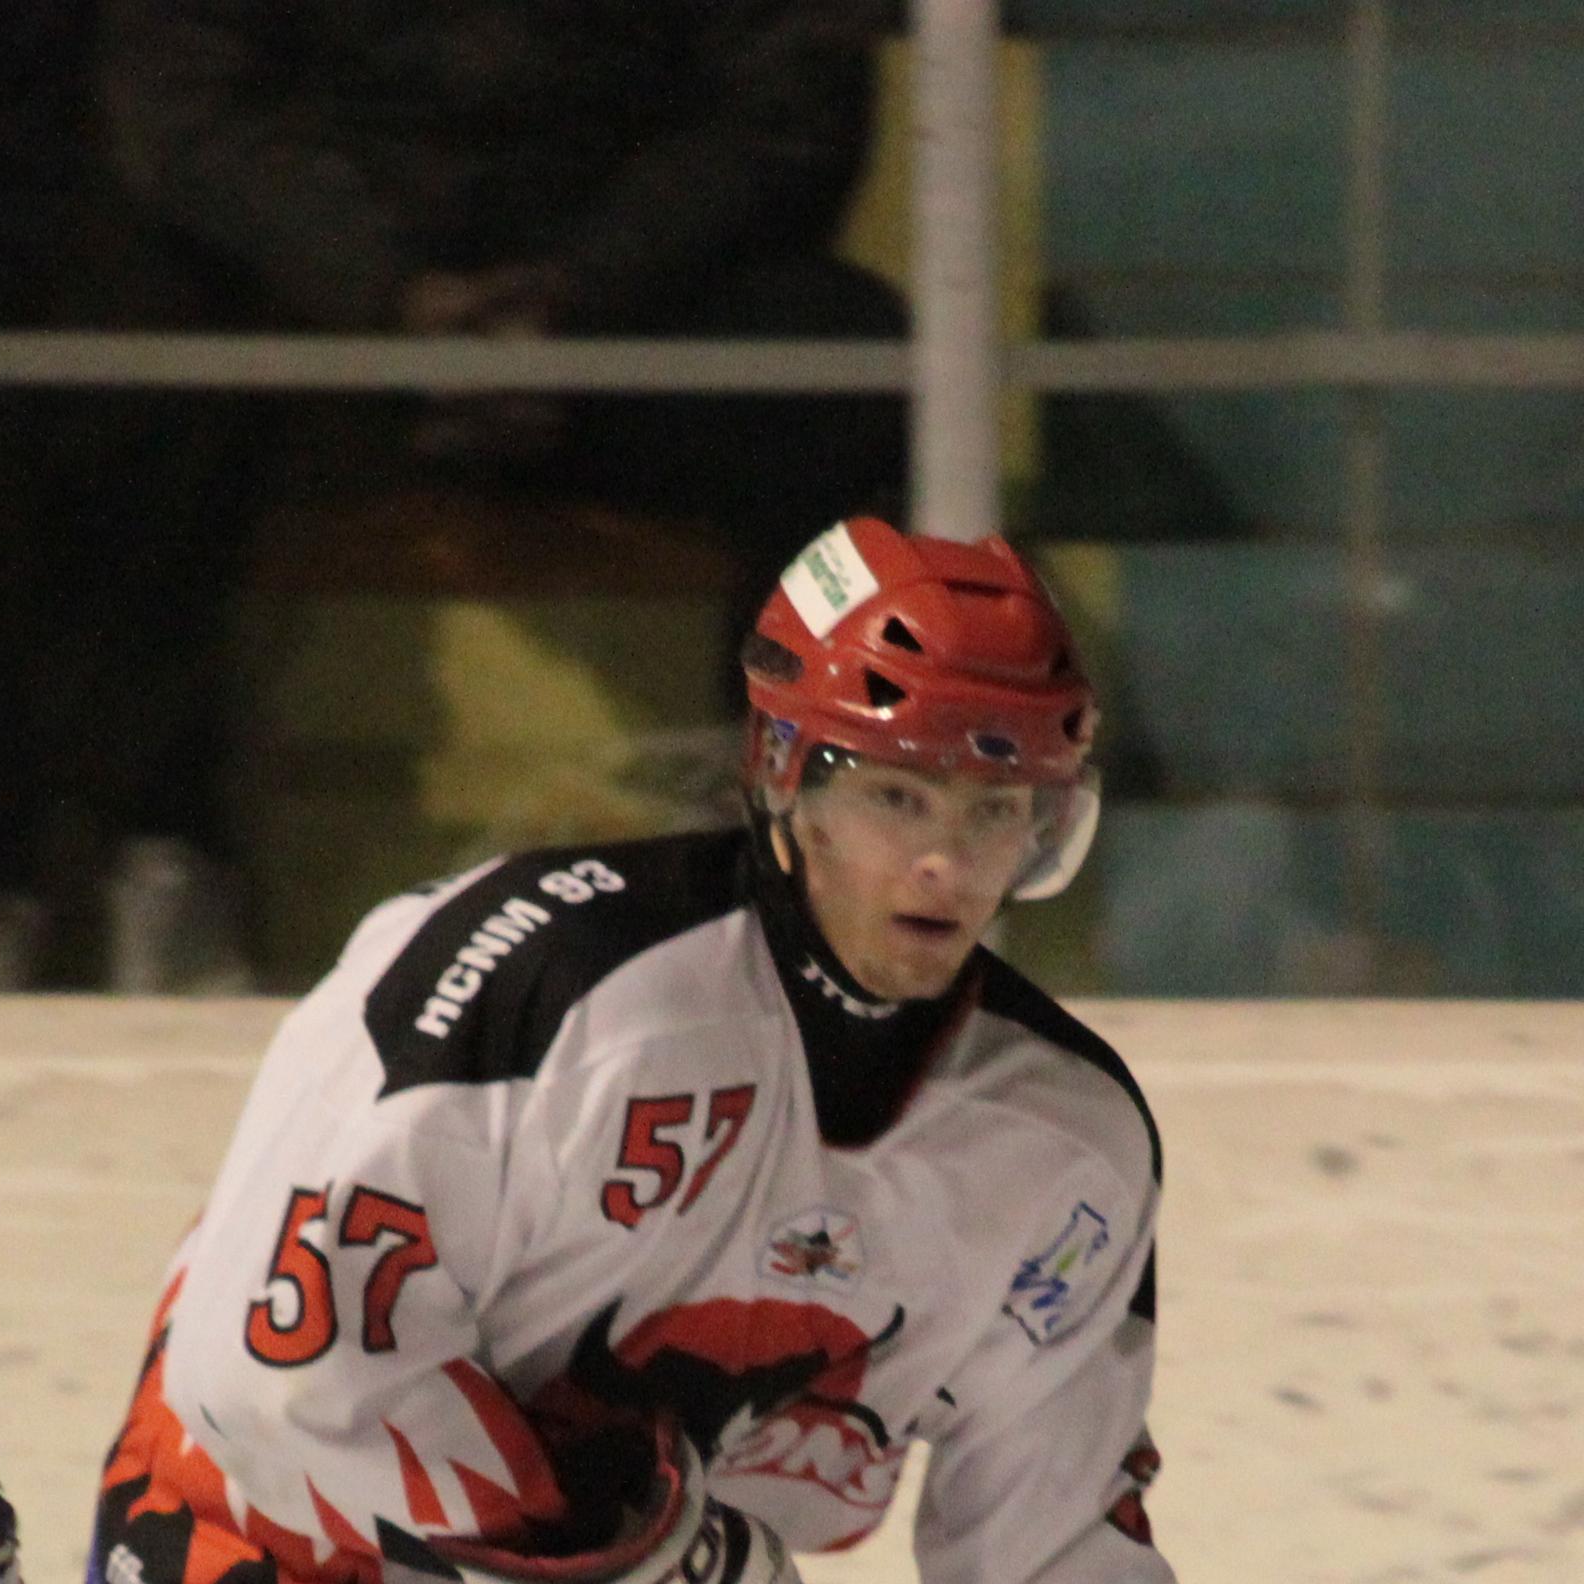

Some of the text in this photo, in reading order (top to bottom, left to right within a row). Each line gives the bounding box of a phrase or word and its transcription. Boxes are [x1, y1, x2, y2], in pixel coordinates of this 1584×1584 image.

[538, 858, 626, 904] 93
[600, 1083, 757, 1230] 57
[244, 1179, 440, 1368] 57
